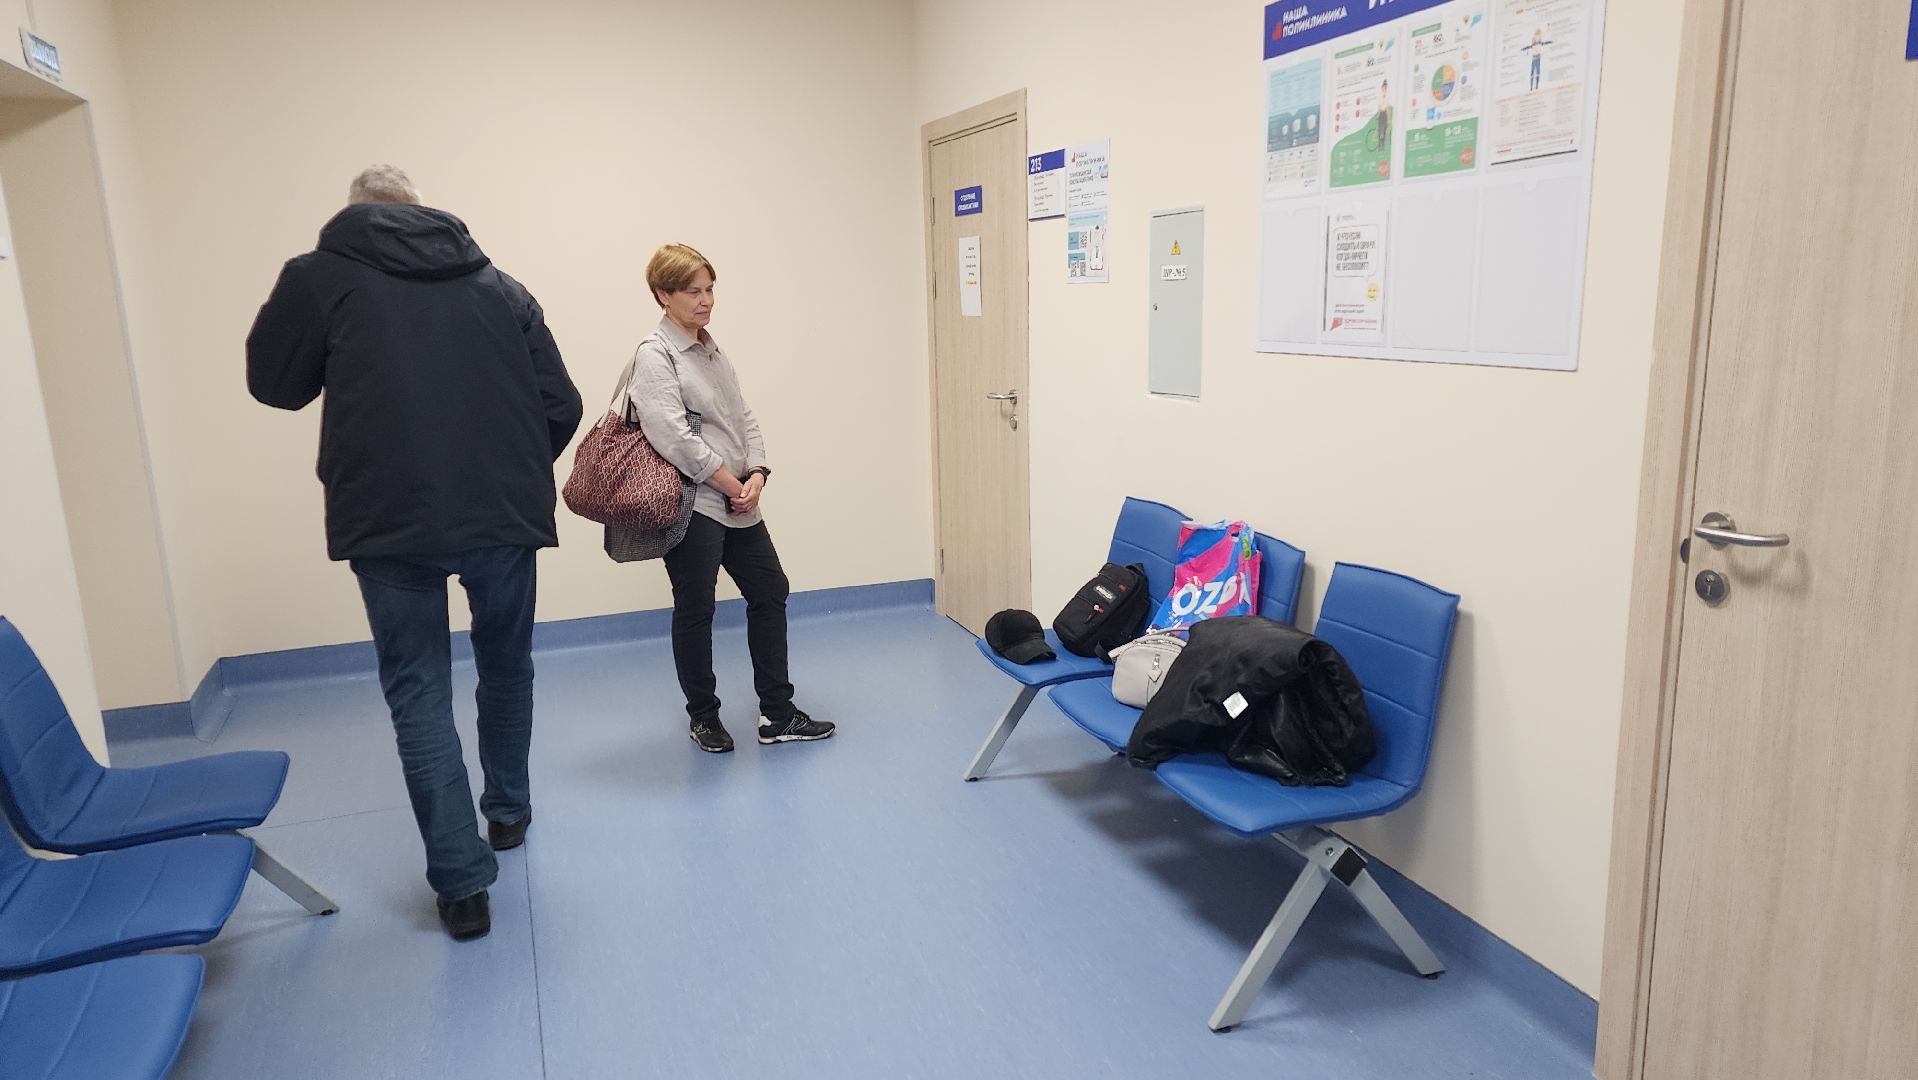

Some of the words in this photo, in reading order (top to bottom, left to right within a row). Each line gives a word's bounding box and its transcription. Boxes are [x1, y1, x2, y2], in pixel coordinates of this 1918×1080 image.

[1282, 4, 1309, 25] НАША
[1282, 5, 1348, 38] ПОЛИКЛИНИКА
[1030, 157, 1042, 172] 213
